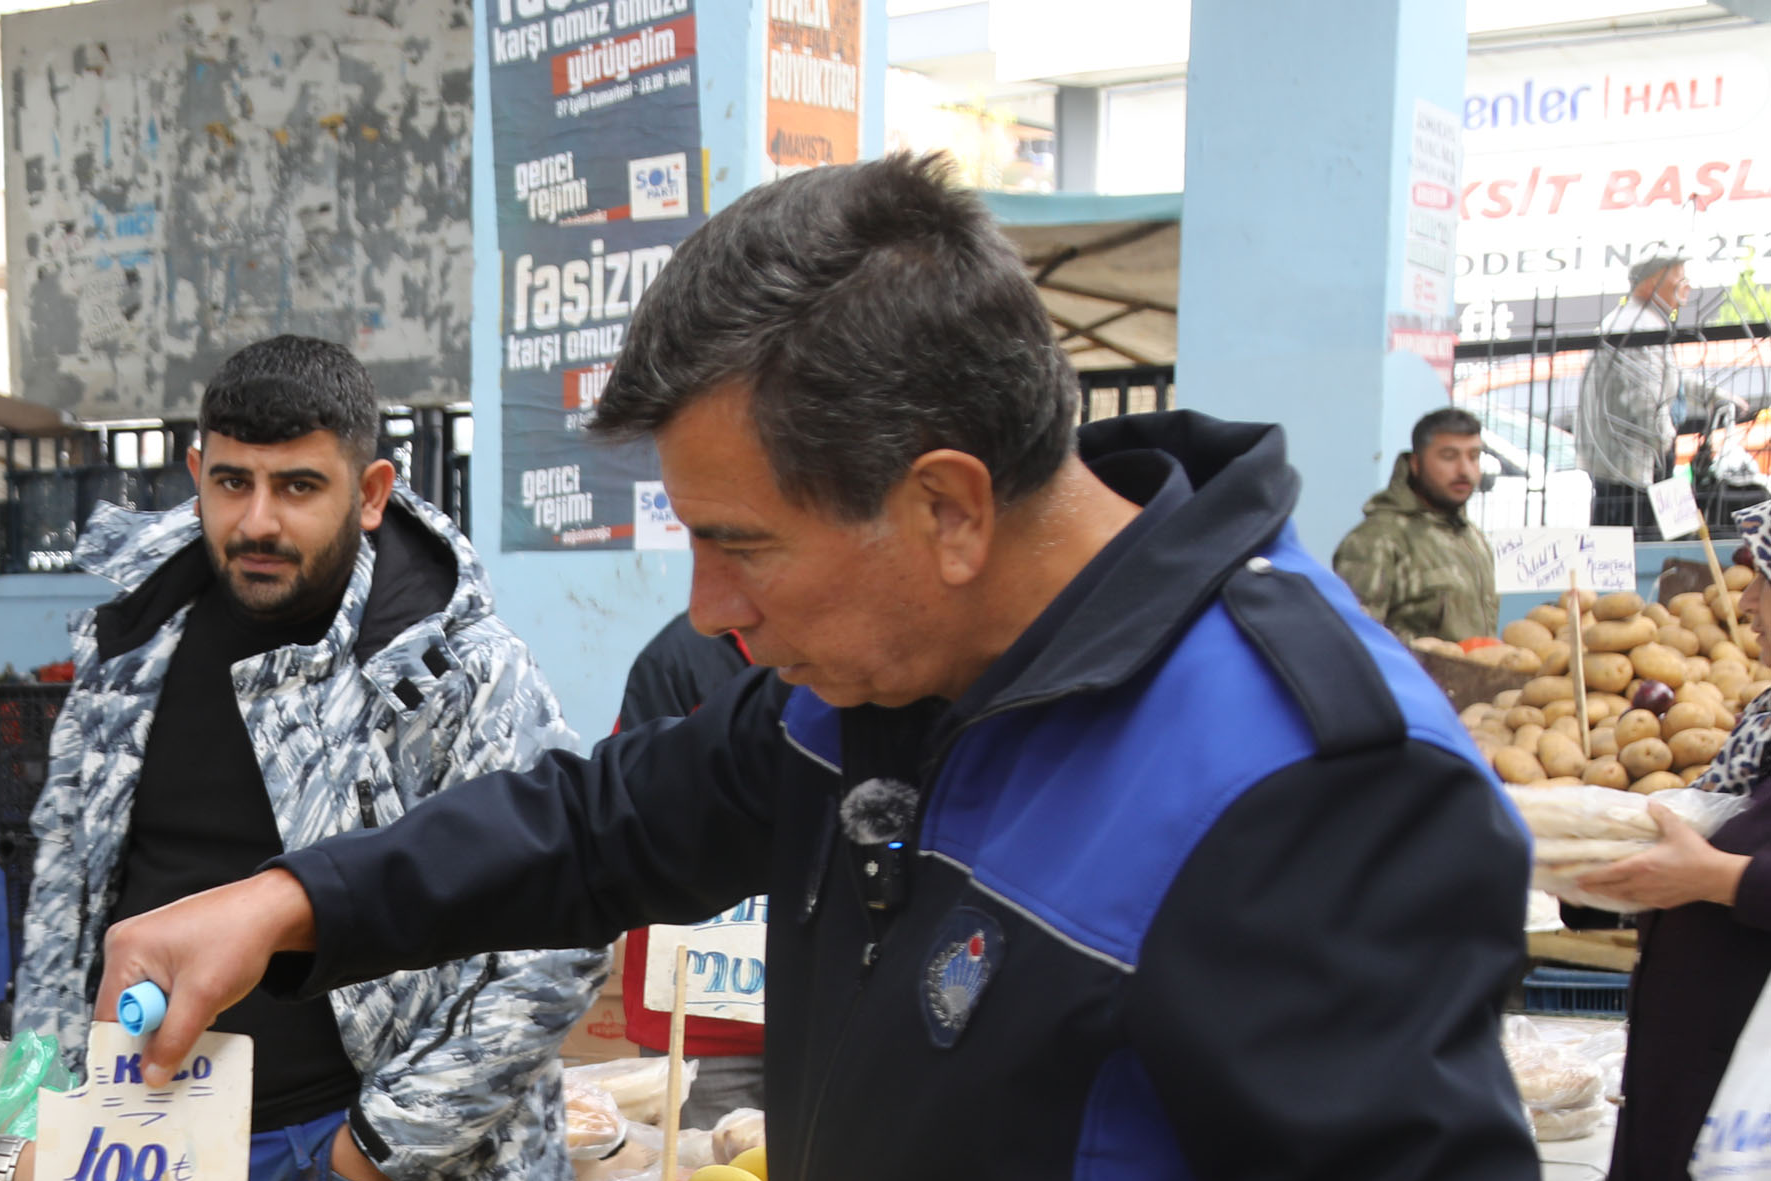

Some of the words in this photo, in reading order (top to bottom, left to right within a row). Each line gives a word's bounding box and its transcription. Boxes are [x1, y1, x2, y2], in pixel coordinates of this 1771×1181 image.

[492, 20, 547, 64] karşı
[552, 2, 610, 47] omuz
[566, 27, 677, 95] yürüyelim
[1622, 75, 1724, 116] HALI
[514, 151, 574, 201] gerici
[1599, 158, 1771, 213] BAŞL
[529, 177, 588, 223] rejimi
[507, 333, 561, 373] karşı
[565, 323, 624, 362] omuz
[522, 464, 580, 508] gerici
[641, 491, 669, 510] SO
[535, 491, 593, 532] rejimi
[113, 1053, 213, 1085] KO
